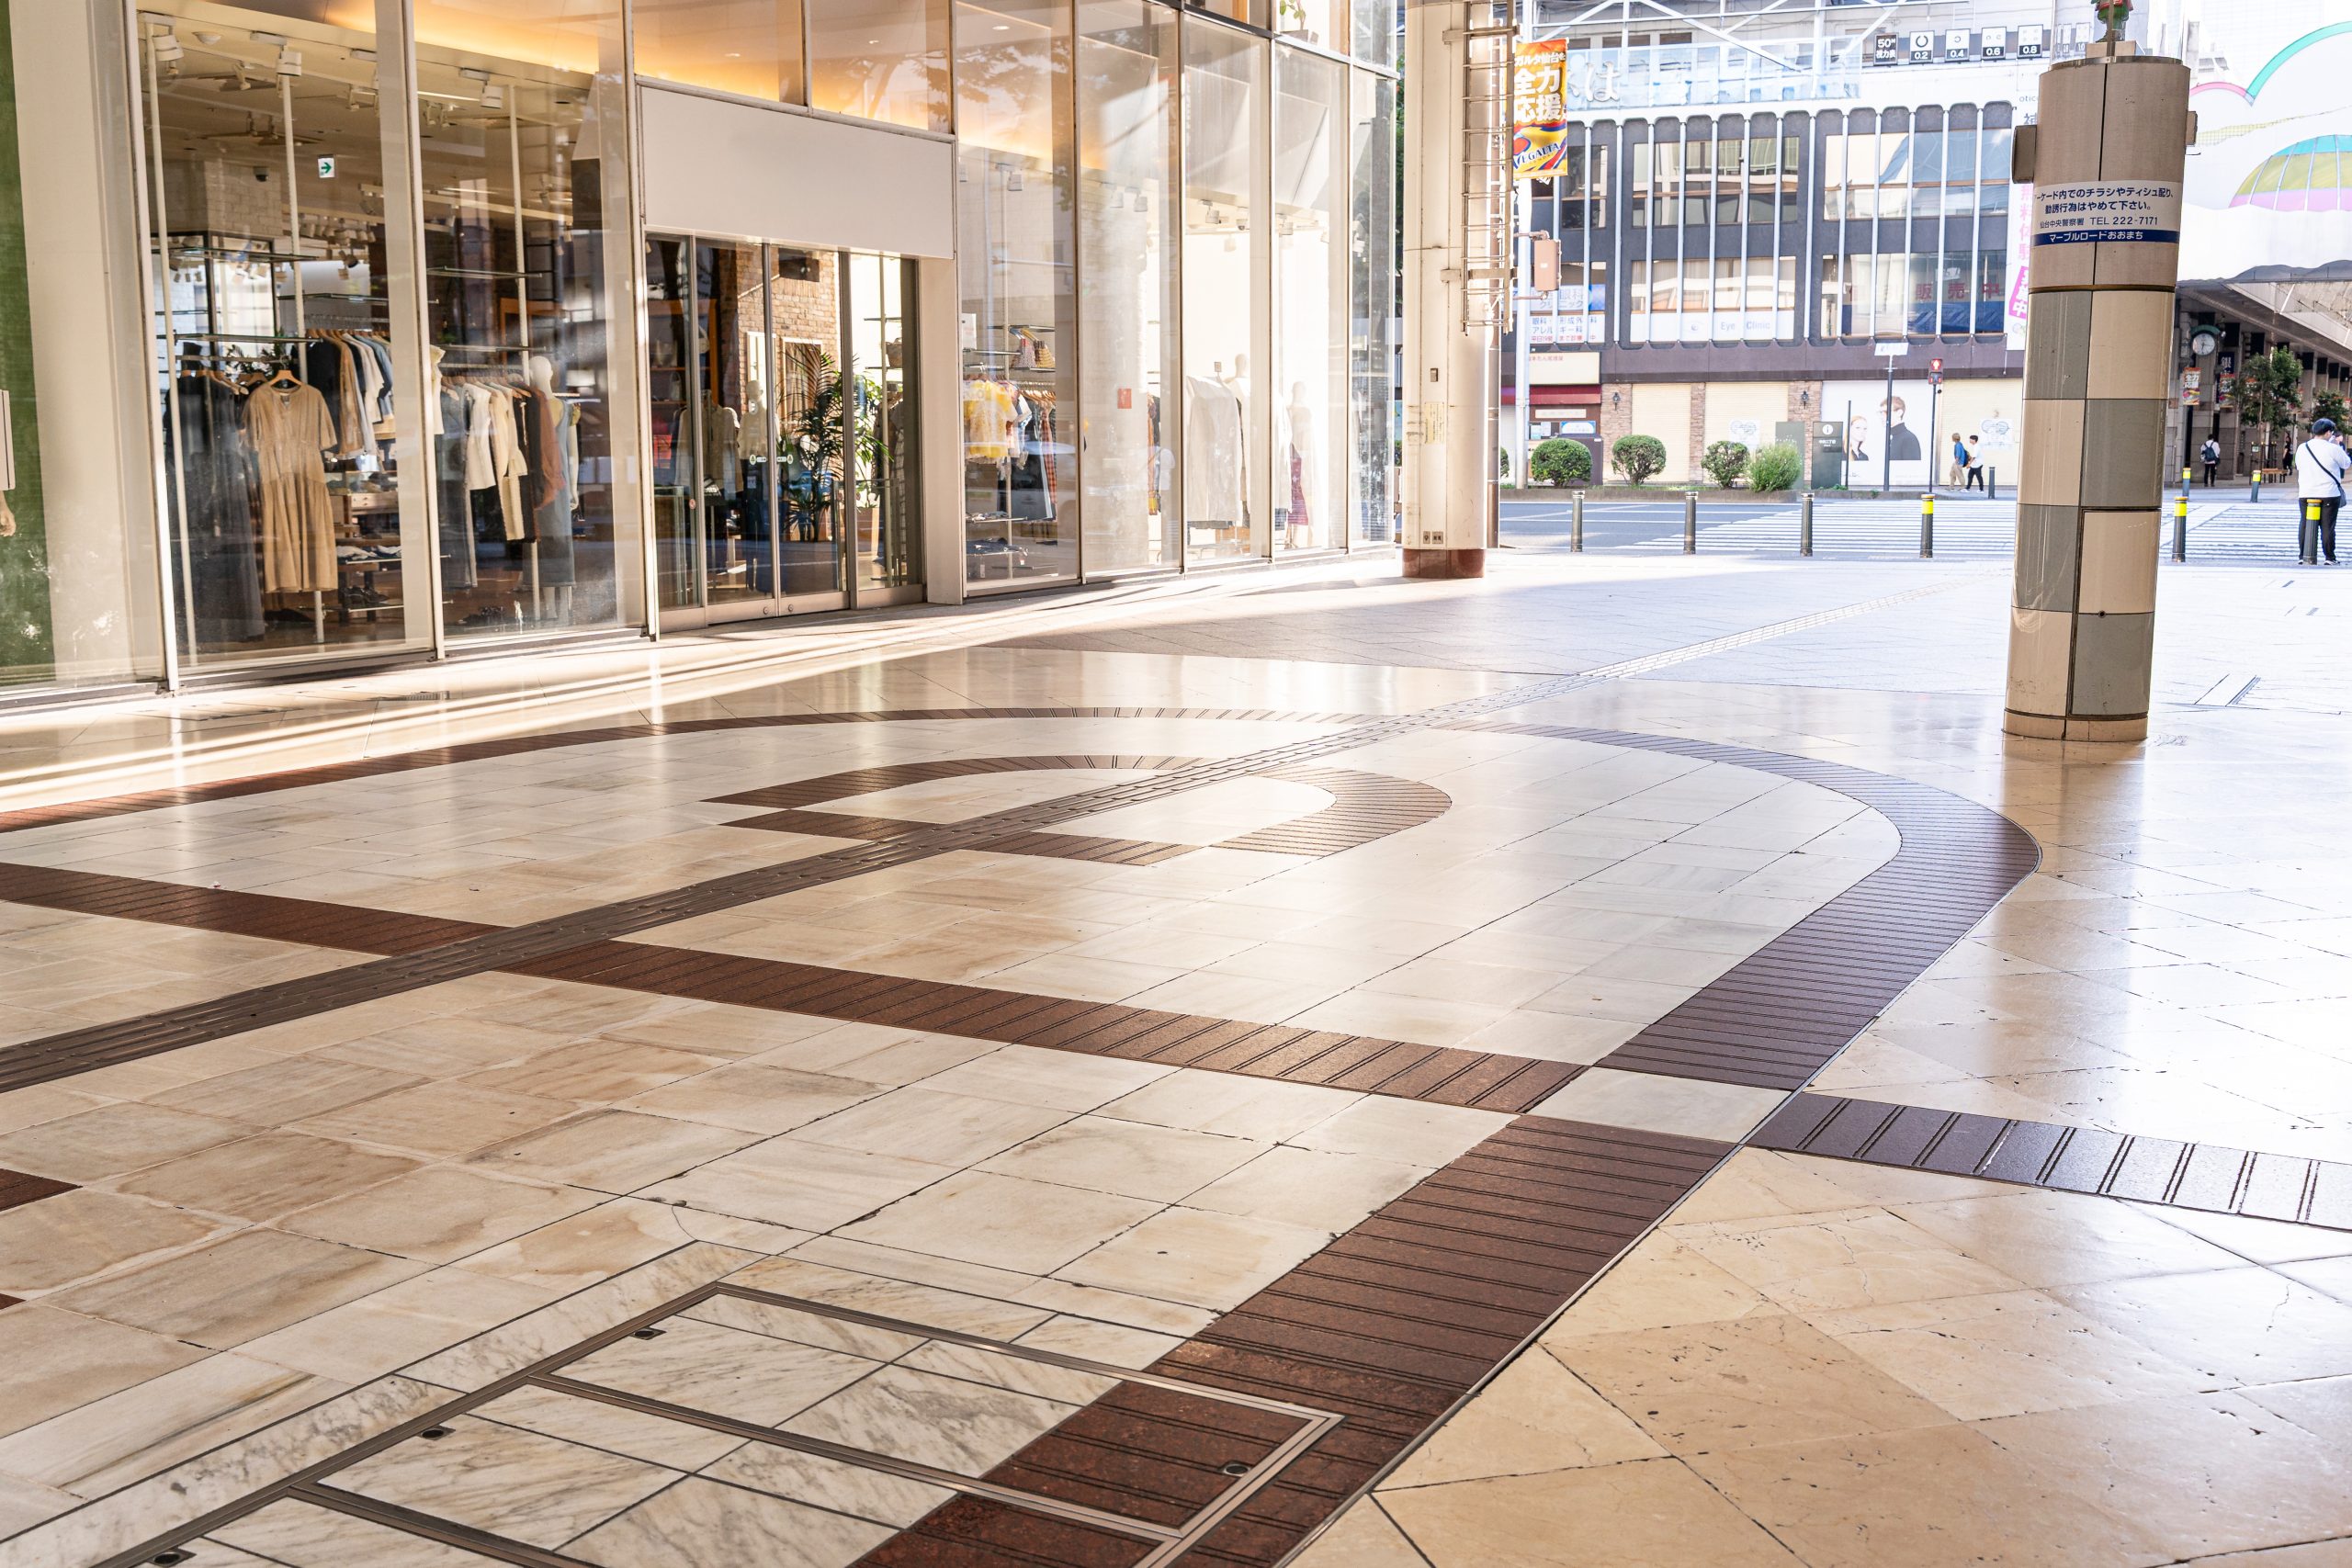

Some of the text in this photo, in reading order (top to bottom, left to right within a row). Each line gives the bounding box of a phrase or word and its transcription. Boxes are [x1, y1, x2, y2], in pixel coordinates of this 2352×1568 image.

[1914, 51, 1928, 60] 0.2
[1950, 49, 1965, 58] 0.4
[1985, 47, 2001, 56] 0.6
[2022, 45, 2038, 54] 0.8
[1514, 52, 1566, 67] ガルタ仙台を
[1514, 66, 1561, 96] 全力
[1514, 93, 1562, 122] 応援
[2035, 186, 2174, 202] ーケード内でのチラシやティシュ配り、
[2045, 200, 2151, 215] 勧誘行為はやめて下さい。
[2040, 216, 2158, 229] 仙台中央警察署 TEL 222-7171
[2049, 230, 2143, 243] マーブルロードおおまち
[1721, 321, 1770, 331] Eye Clinic
